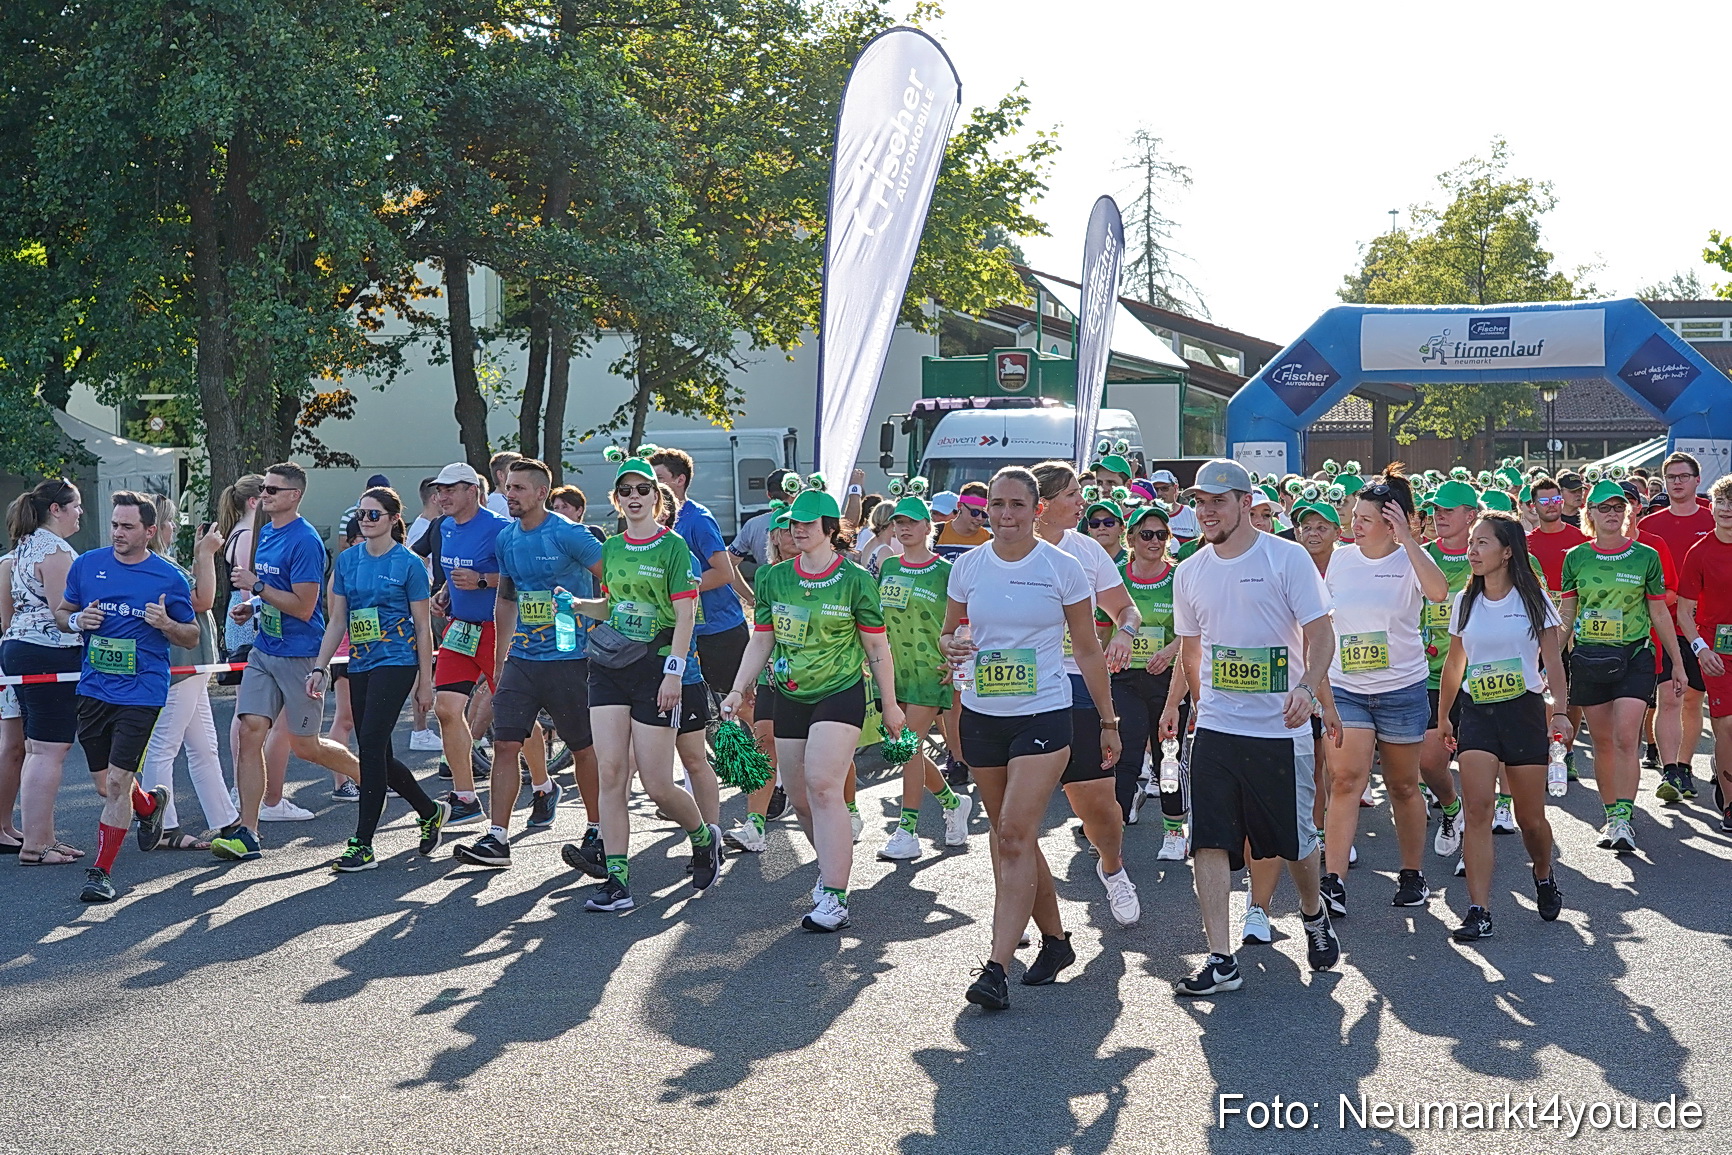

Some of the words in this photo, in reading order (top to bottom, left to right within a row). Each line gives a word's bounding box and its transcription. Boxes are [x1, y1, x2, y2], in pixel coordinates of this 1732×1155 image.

[868, 67, 927, 211] Fischer
[896, 86, 936, 204] AUTOMOBILE
[1094, 222, 1115, 316] Fischer
[1454, 339, 1544, 359] firmenlauf
[1454, 357, 1492, 366] neumarkt
[1281, 368, 1329, 382] Fischer
[1633, 367, 1647, 377] und
[1648, 364, 1661, 374] das
[937, 436, 978, 446] abavent
[624, 538, 664, 552] MONSTERSTARK
[1596, 549, 1633, 562] MONSTERSTARK
[899, 563, 938, 575] MONSTERSTARK
[799, 572, 844, 589] MONSTERSTARK
[1131, 577, 1170, 590] MONSTERSTARK
[881, 585, 901, 597] 333
[901, 589, 910, 604] 2022
[522, 602, 545, 614] 1917
[351, 619, 373, 634] 1903
[625, 615, 643, 628] 44
[777, 616, 792, 632] 53
[1592, 620, 1607, 632] 87
[635, 628, 649, 636] Laura
[784, 631, 798, 639] Laura
[797, 623, 806, 642] 2022
[470, 637, 478, 652] 2022
[1132, 638, 1149, 650] 93
[98, 648, 123, 663] 739
[1345, 645, 1379, 661] 1879
[984, 664, 1027, 682] 1878
[1220, 661, 1260, 679] 1896
[1477, 673, 1515, 691] 1876
[1515, 674, 1524, 692] 2022
[1471, 681, 1479, 700] WALK
[1481, 689, 1501, 697] Nguyen
[1501, 687, 1515, 695] Minh
